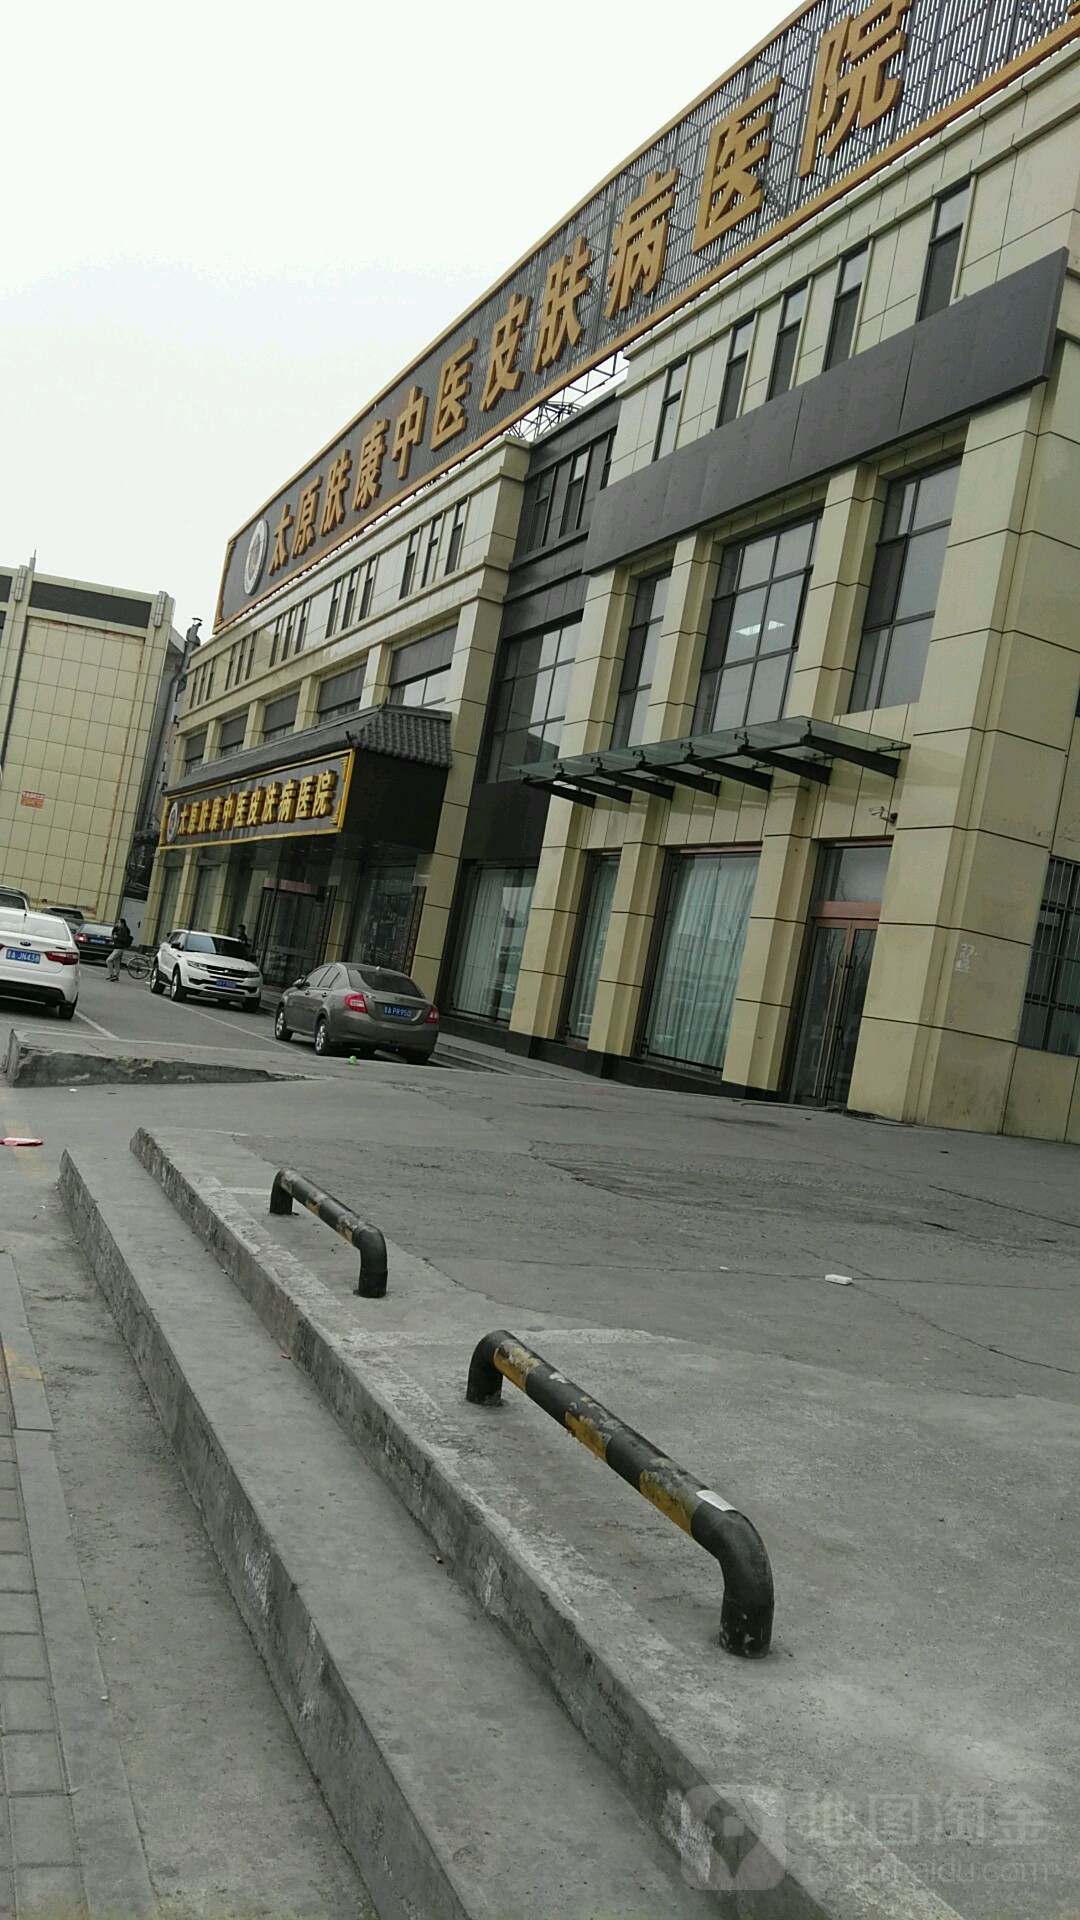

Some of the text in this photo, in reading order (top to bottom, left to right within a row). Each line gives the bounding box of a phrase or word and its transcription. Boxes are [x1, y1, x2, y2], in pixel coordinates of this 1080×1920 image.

[268, 0, 911, 576] 太原肤康中医皮肤病医院
[177, 769, 337, 836] 太原肤康中医皮肤病医院
